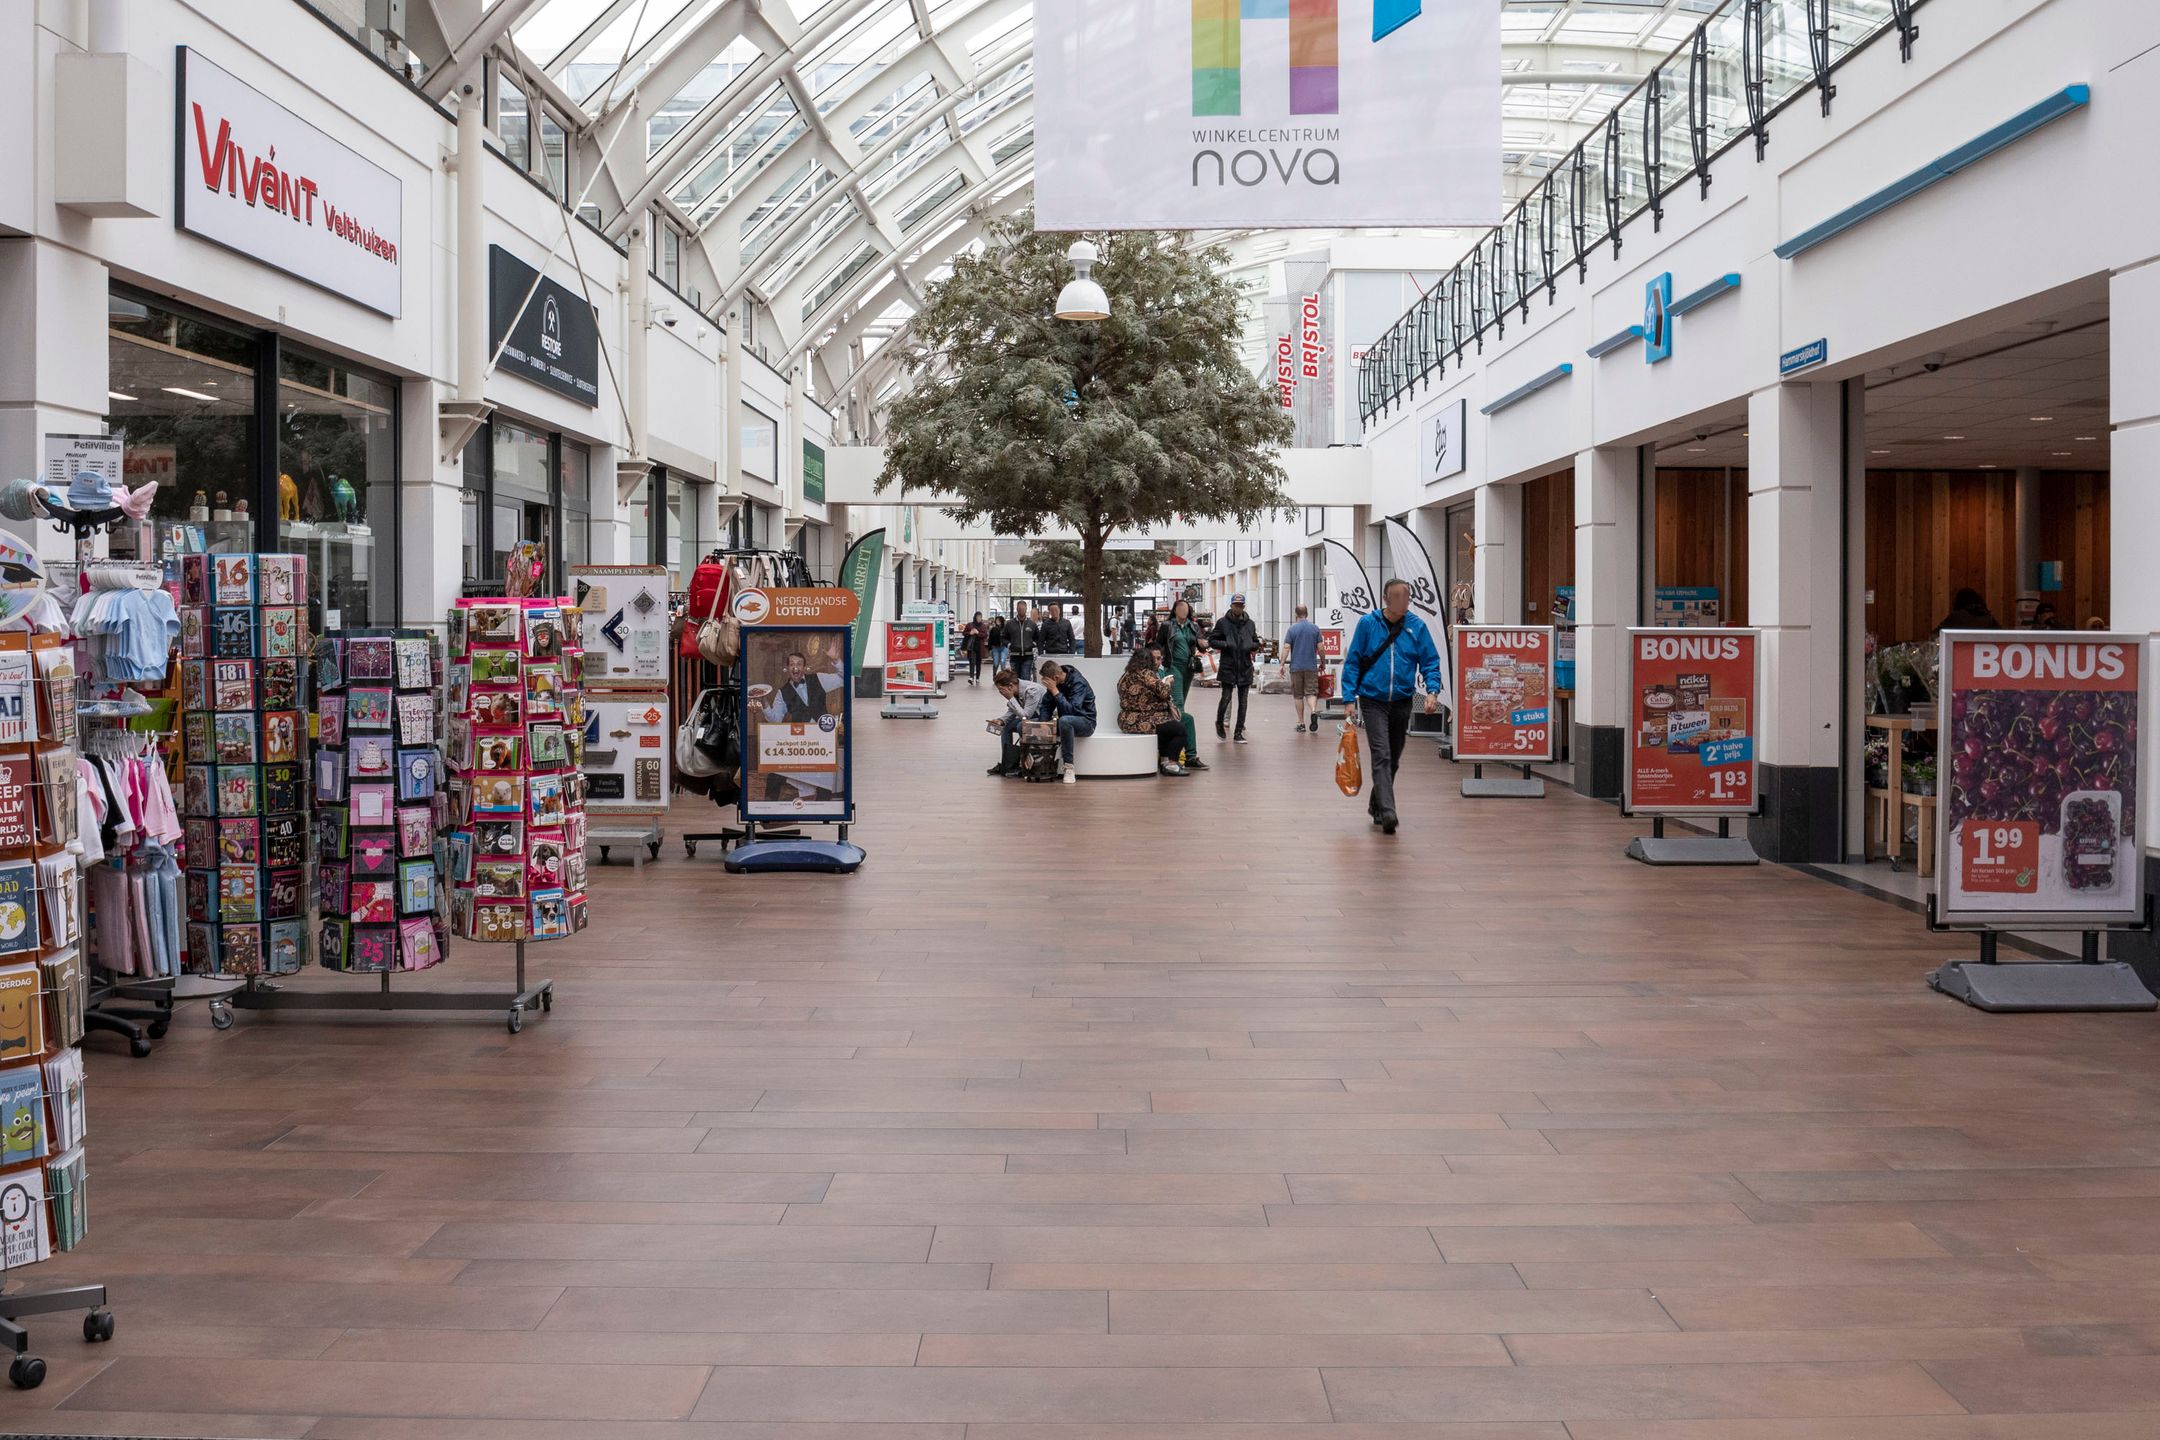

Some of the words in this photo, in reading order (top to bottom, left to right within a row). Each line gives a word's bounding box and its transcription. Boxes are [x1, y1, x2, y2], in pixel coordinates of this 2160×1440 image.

[1192, 128, 1340, 143] WINKELCENTRUM
[1192, 148, 1340, 187] nova
[323, 200, 398, 265] Velthuizen
[1302, 293, 1325, 378] BRISTOL
[541, 333, 562, 357] RESTORE
[530, 356, 546, 372] STOMERIJ
[1277, 334, 1298, 409] BRISTOL
[74, 441, 120, 451] PetitVillain
[217, 558, 249, 587] 16
[578, 584, 588, 592] 28
[775, 596, 848, 606] NEDERLANDSE
[775, 607, 820, 617] LOTERIJ
[222, 612, 247, 634] 16
[275, 623, 288, 633] 30
[617, 626, 630, 635] 30
[895, 636, 904, 646] 2
[1466, 631, 1541, 649] BONUS
[1641, 637, 1740, 660] BONUS
[1973, 643, 2125, 680] BONUS
[220, 664, 238, 682] 18
[0, 696, 23, 717] AD
[1650, 695, 1670, 704] Calvé
[647, 713, 657, 721] 25
[820, 716, 833, 725] 50
[1514, 714, 1521, 722] 3
[1522, 711, 1545, 721] stuks
[1670, 718, 1707, 733] B'tween
[775, 740, 798, 748] Jackpot
[806, 739, 820, 748] juni
[1722, 742, 1744, 751] halve
[764, 748, 771, 756] €
[772, 747, 833, 757] 14.300.000,-
[1723, 751, 1741, 760] prijs
[646, 760, 659, 770] 60
[0, 784, 22, 798] EP
[1709, 771, 1747, 799] 1.93
[280, 820, 293, 836] 40
[320, 820, 338, 845] 50
[6, 834, 31, 846] DAD
[1972, 827, 2023, 865] 1.99
[272, 882, 297, 904] 40
[230, 935, 251, 945] 21
[322, 931, 341, 955] 60
[360, 937, 385, 962] 25
